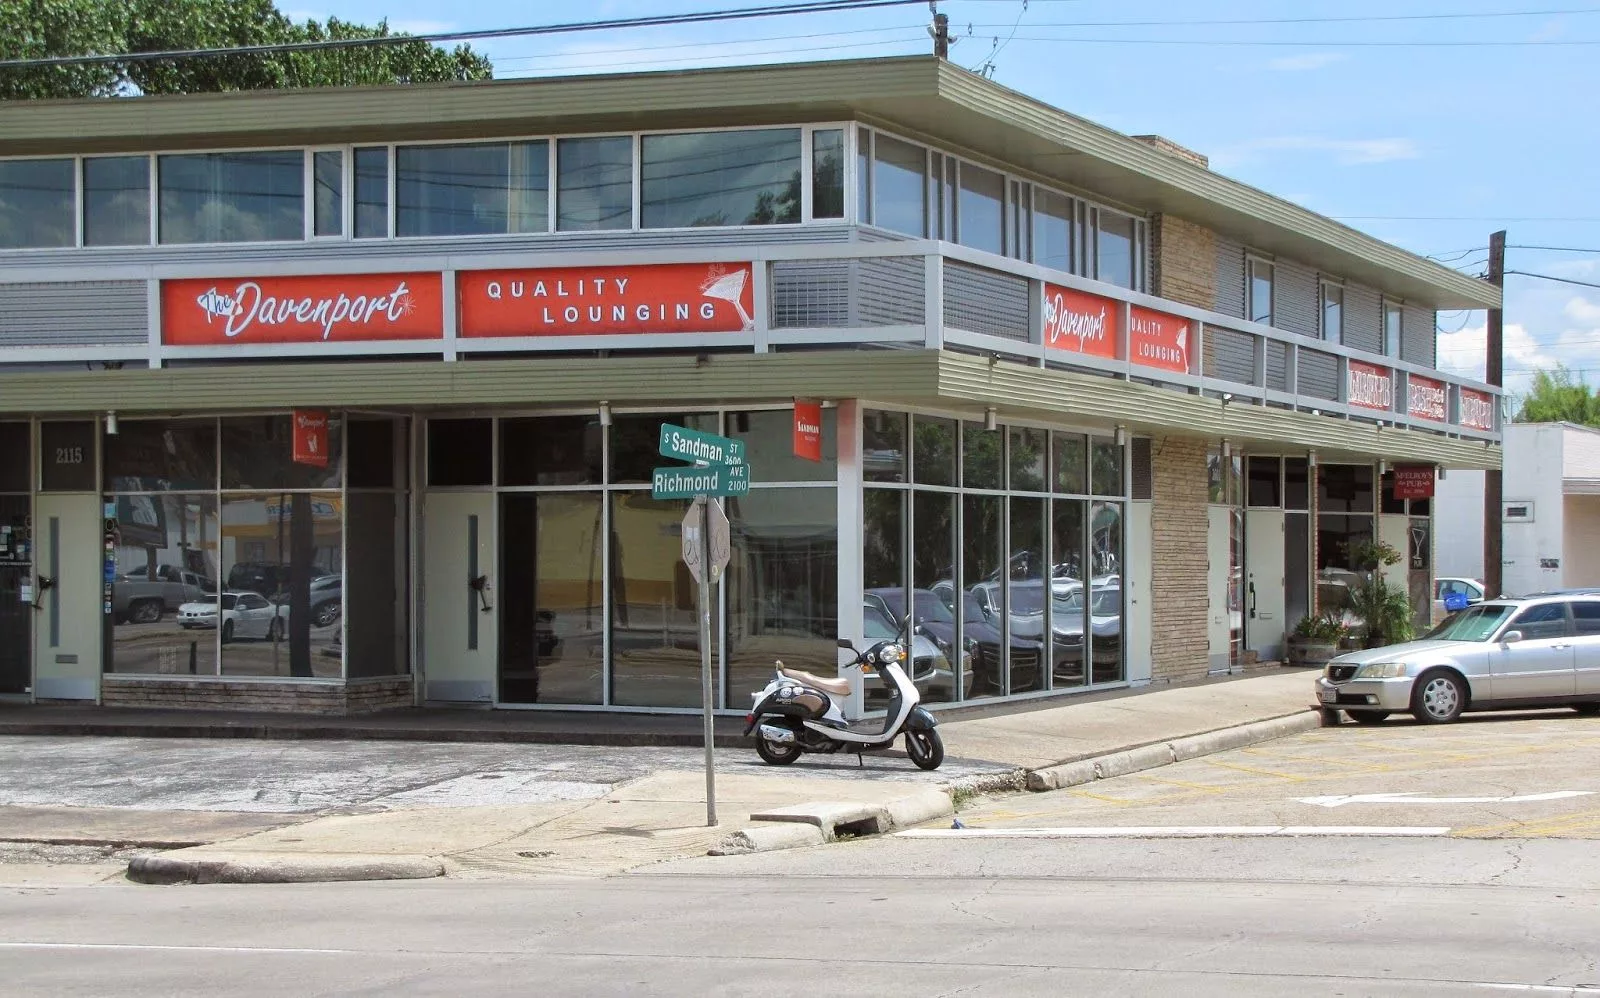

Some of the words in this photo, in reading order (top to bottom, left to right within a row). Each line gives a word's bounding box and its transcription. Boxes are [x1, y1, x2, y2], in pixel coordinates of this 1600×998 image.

[487, 278, 629, 299] QUALITY
[199, 287, 231, 323] The
[225, 281, 409, 339] Davenport
[543, 303, 715, 323] LOUNGING
[1050, 293, 1105, 352] Davenport
[1131, 317, 1161, 336] UALITY
[1139, 342, 1181, 363] LOUNGING
[56, 446, 83, 464] 2115
[664, 432, 670, 443] S
[672, 431, 723, 461] Sandman
[729, 443, 738, 454] ST
[655, 471, 718, 493] Richmond
[729, 466, 744, 477] AVE
[728, 480, 747, 491] 2100
